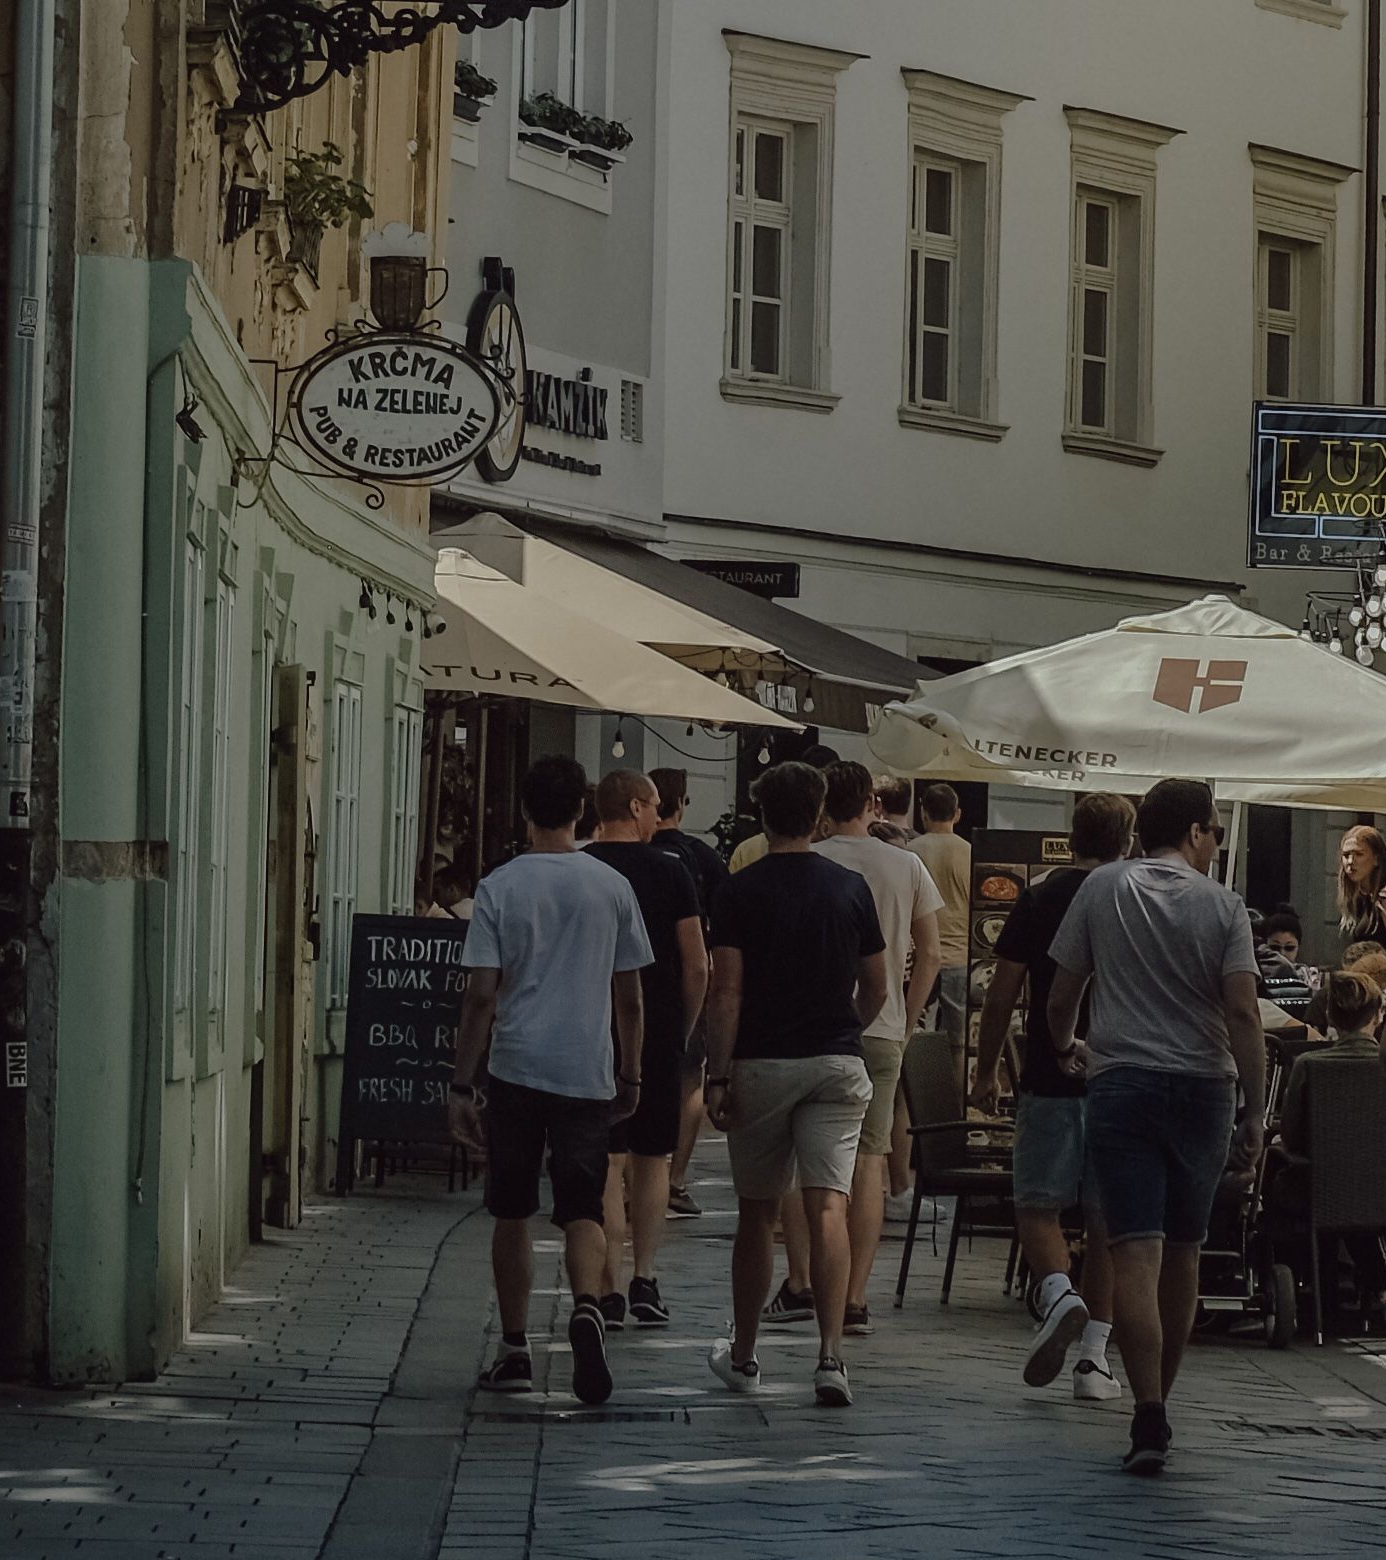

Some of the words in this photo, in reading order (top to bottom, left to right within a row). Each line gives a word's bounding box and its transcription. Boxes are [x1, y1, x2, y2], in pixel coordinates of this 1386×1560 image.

[348, 346, 455, 391] KRČMA
[337, 388, 368, 411] NA
[374, 388, 463, 416] ZELENEJ
[309, 405, 343, 445] PUB
[342, 437, 359, 461] &
[364, 408, 487, 469] RESTAURANT
[1255, 542, 1289, 560] Bar
[1297, 543, 1312, 562] &
[365, 967, 432, 991] SLOVAK
[369, 1023, 419, 1049] BBQ
[7, 1043, 27, 1086] BNE
[358, 1077, 413, 1103] FRESH
